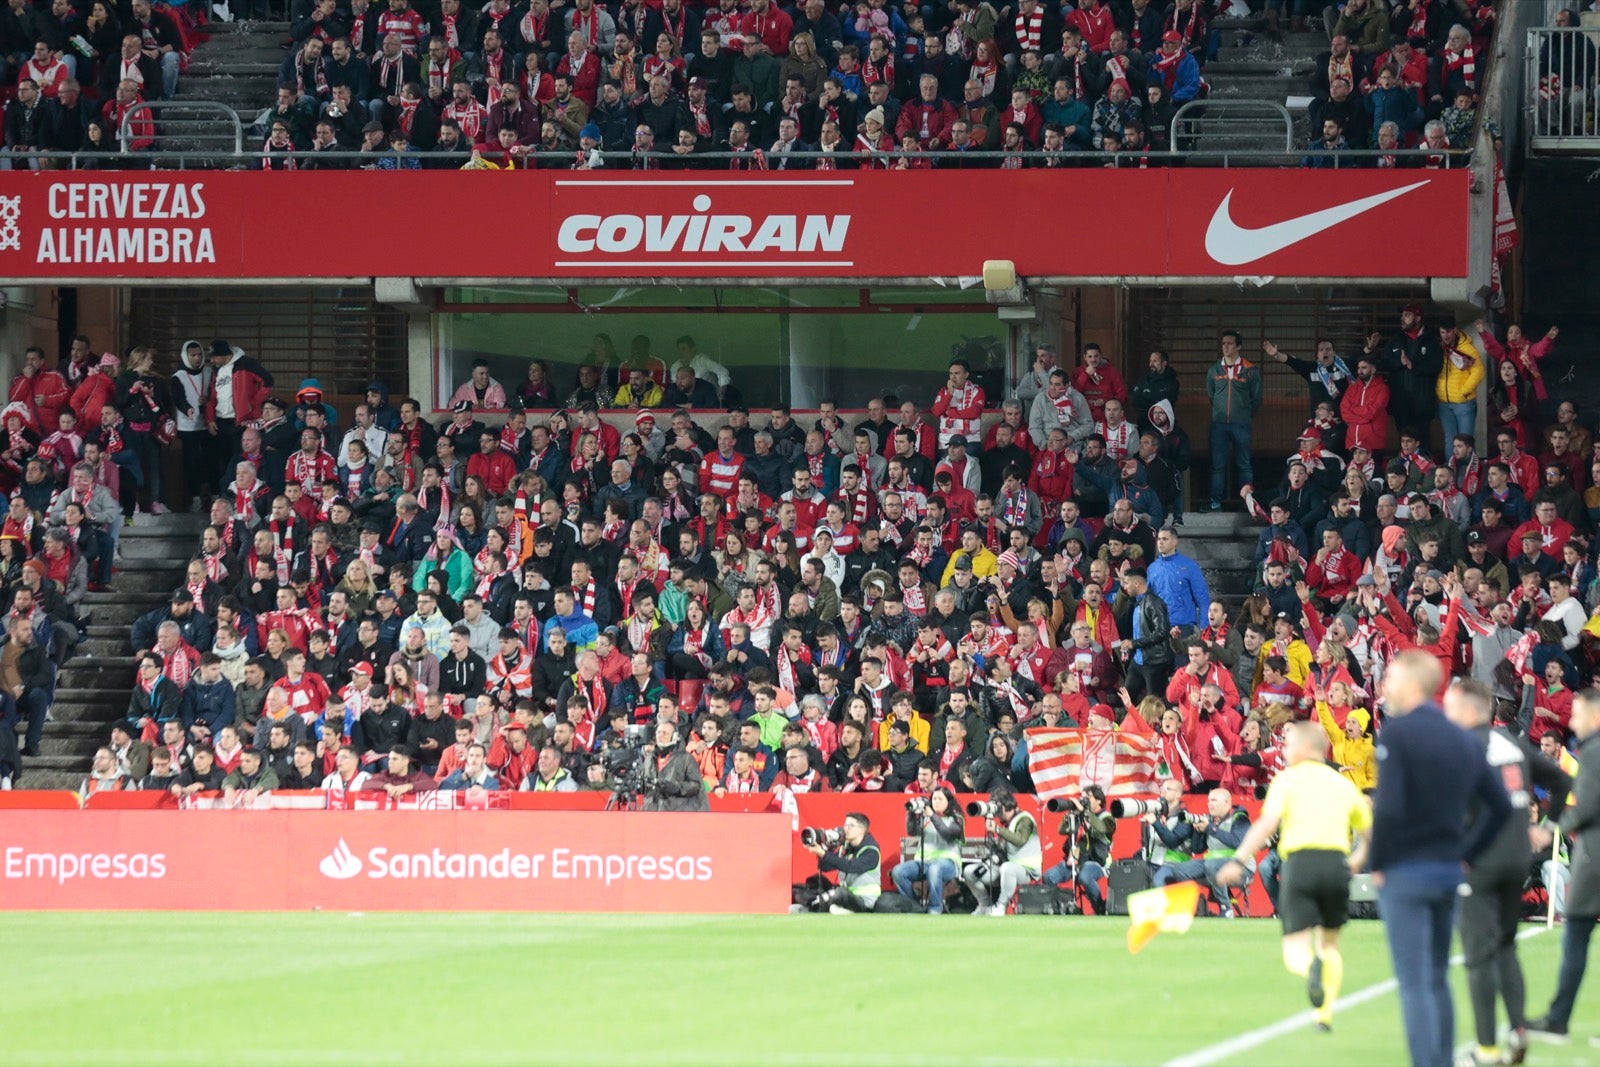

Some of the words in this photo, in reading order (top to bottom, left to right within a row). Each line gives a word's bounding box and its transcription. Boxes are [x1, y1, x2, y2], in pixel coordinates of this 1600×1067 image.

[48, 183, 206, 219] CERVEZAS
[36, 227, 216, 263] ALHAMBRA
[5, 847, 167, 884] Empresas
[367, 847, 545, 879] Santander
[551, 848, 713, 885] Empresas
